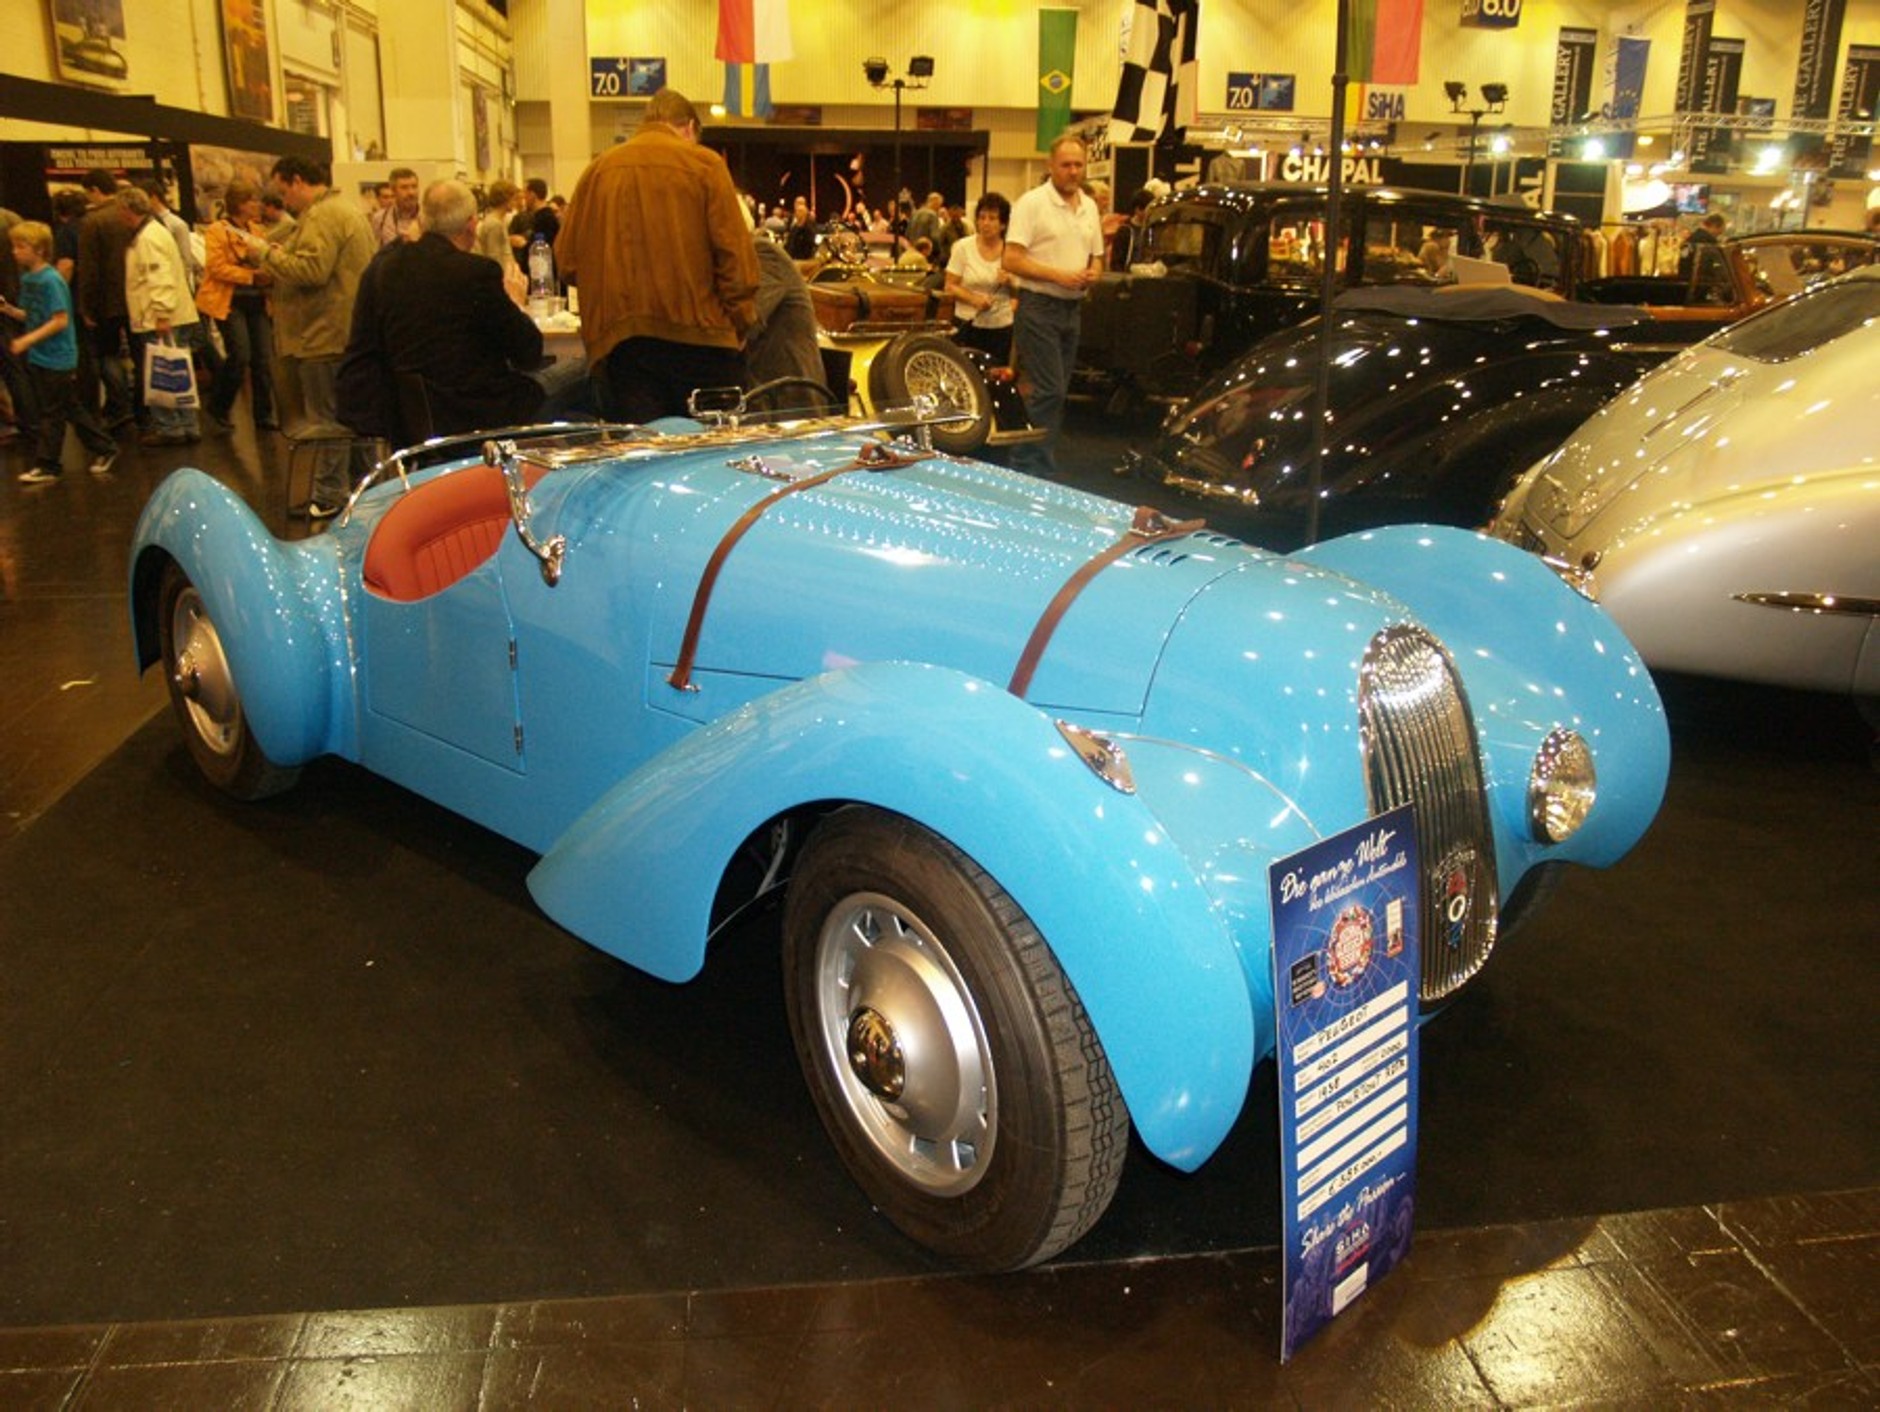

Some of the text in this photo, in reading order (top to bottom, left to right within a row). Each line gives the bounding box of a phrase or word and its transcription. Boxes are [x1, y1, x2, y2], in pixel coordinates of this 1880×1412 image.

[593, 72, 620, 95] 7.0
[1229, 87, 1254, 109] 7.0
[1553, 45, 1572, 119] GALLERY
[1280, 867, 1308, 904] Die
[1354, 828, 1396, 868] Welt
